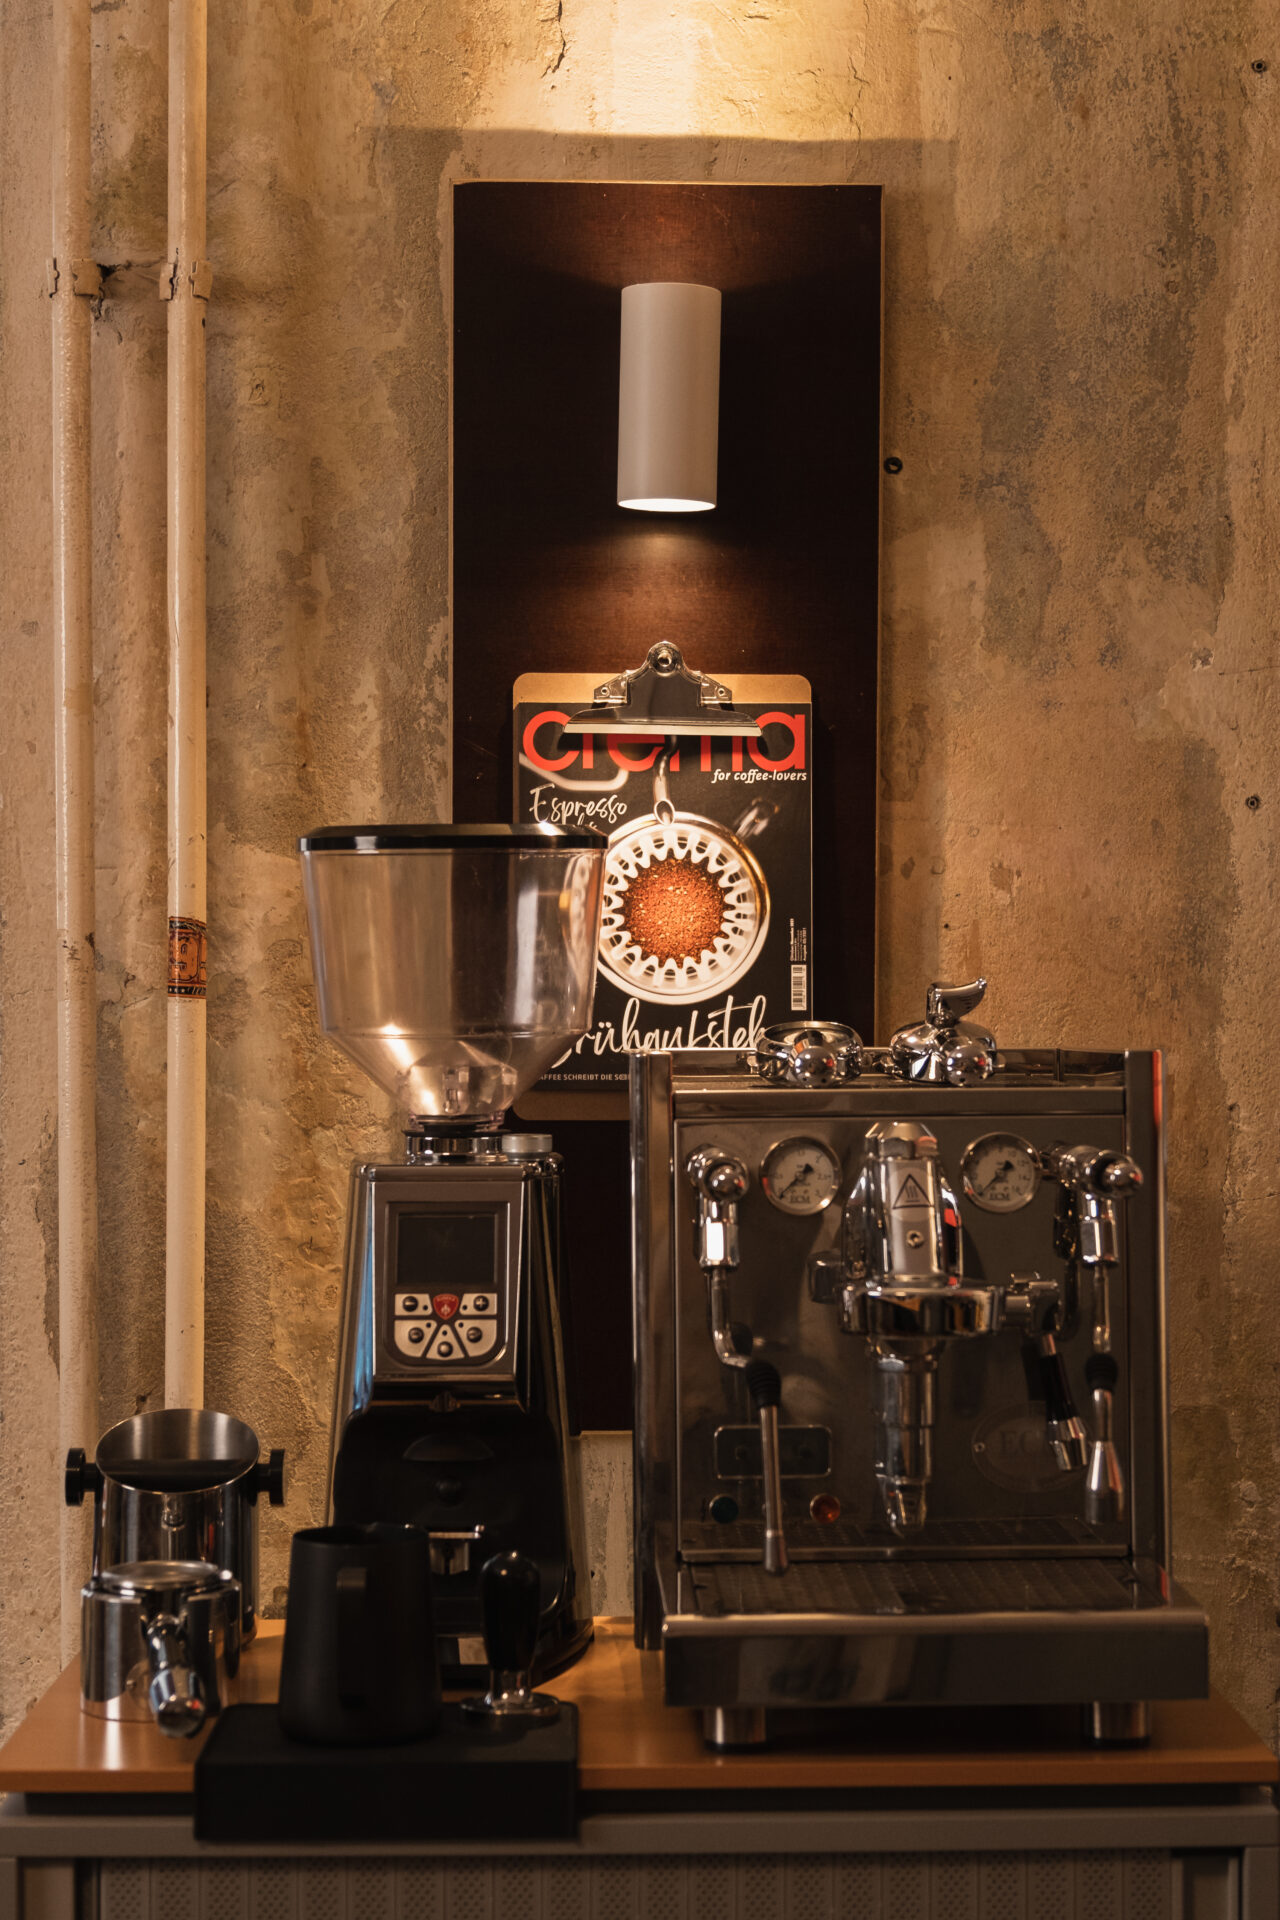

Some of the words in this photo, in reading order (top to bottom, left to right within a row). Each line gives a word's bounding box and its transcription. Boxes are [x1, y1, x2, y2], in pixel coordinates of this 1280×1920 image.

[711, 769, 730, 783] for
[733, 769, 807, 781] coffee-lovers
[529, 783, 628, 825] Espresso
[538, 1073, 561, 1081] AFFEE
[563, 1073, 599, 1081] SCHREIBT
[600, 1073, 613, 1081] DIE
